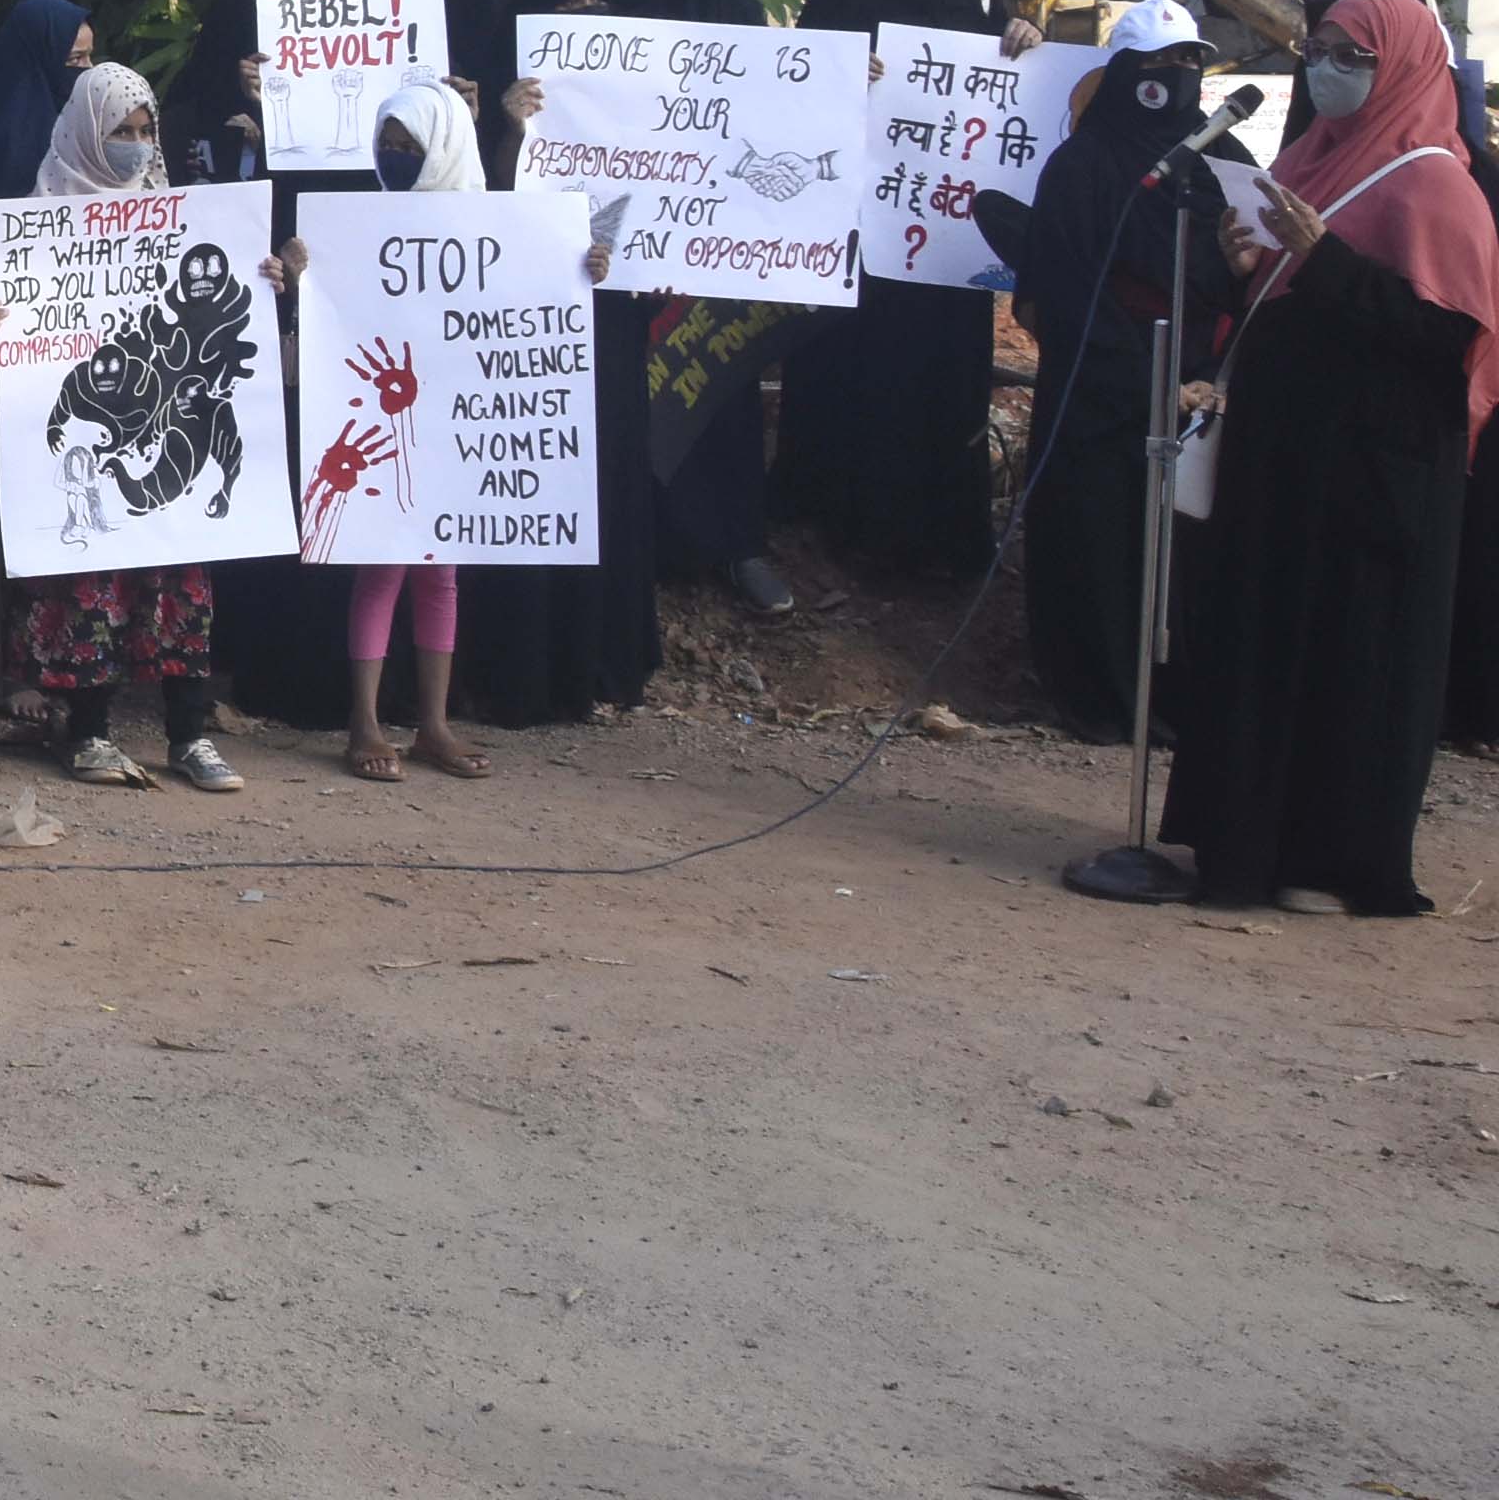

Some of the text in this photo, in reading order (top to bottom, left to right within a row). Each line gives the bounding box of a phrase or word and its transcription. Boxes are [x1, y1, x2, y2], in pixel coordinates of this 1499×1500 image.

[275, 22, 418, 78] REVOLT!
[530, 31, 811, 93] ALONE GIRL IS
[907, 42, 1020, 113] मेरा कसूर
[651, 95, 730, 139] YOUR
[886, 117, 936, 153] क्या
[995, 115, 1038, 169] कि
[1, 190, 188, 244] DEAR RAPIST,
[654, 196, 729, 227] NOT
[929, 173, 977, 221] बेटी
[2, 231, 183, 274] AT WHAT AGE
[623, 229, 672, 260] AN
[904, 224, 928, 271] ?
[378, 235, 501, 297] STOP
[0, 276, 40, 307] DID
[50, 272, 95, 302] YOU
[23, 302, 91, 335] YOUR
[443, 304, 586, 342] DOMESTIC
[475, 343, 590, 380] VIOLENCE
[451, 388, 572, 421] AGAINST
[455, 425, 580, 464] WOMEN
[478, 469, 540, 500] AND
[433, 512, 579, 547] CHILDREN
